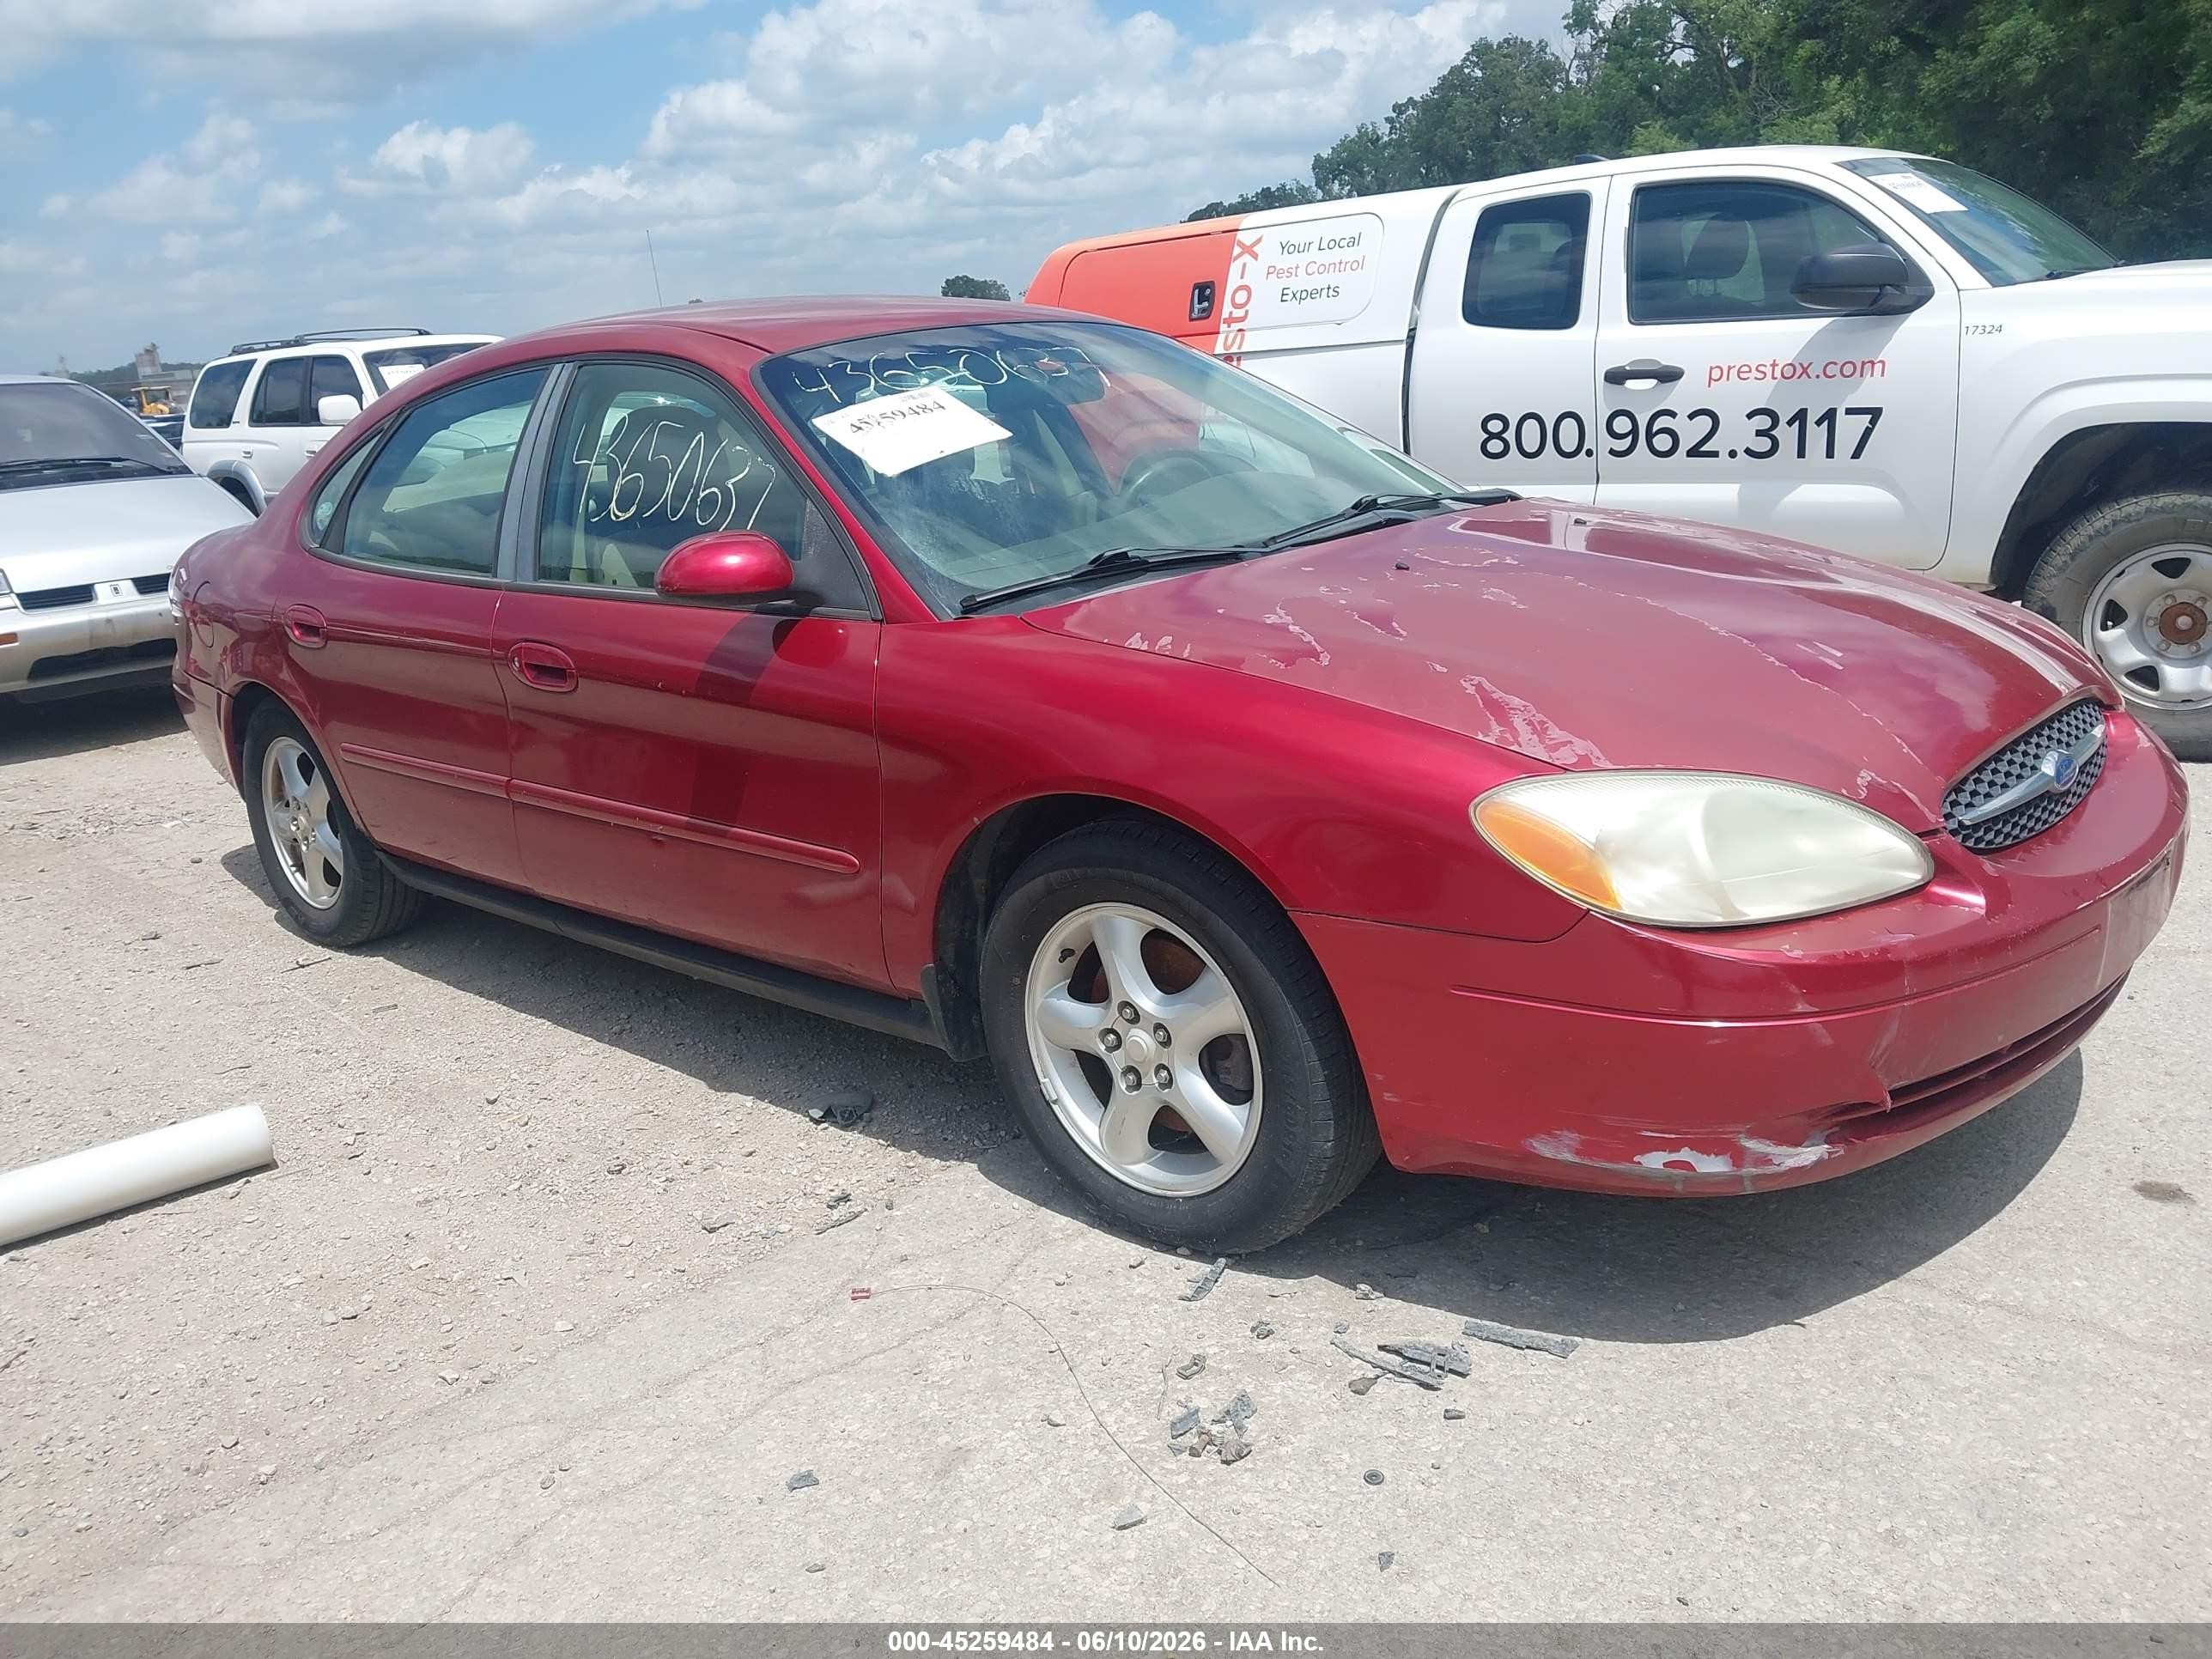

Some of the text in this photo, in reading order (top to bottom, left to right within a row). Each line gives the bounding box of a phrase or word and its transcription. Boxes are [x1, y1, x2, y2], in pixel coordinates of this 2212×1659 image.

[1279, 232, 1363, 256] Your Local
[1266, 255, 1366, 281] Pest Control
[1279, 283, 1340, 304] Experts
[1963, 323, 2003, 336] 17324
[1707, 357, 1887, 389] prestox.com
[1480, 405, 1883, 461] 800.962.3117
